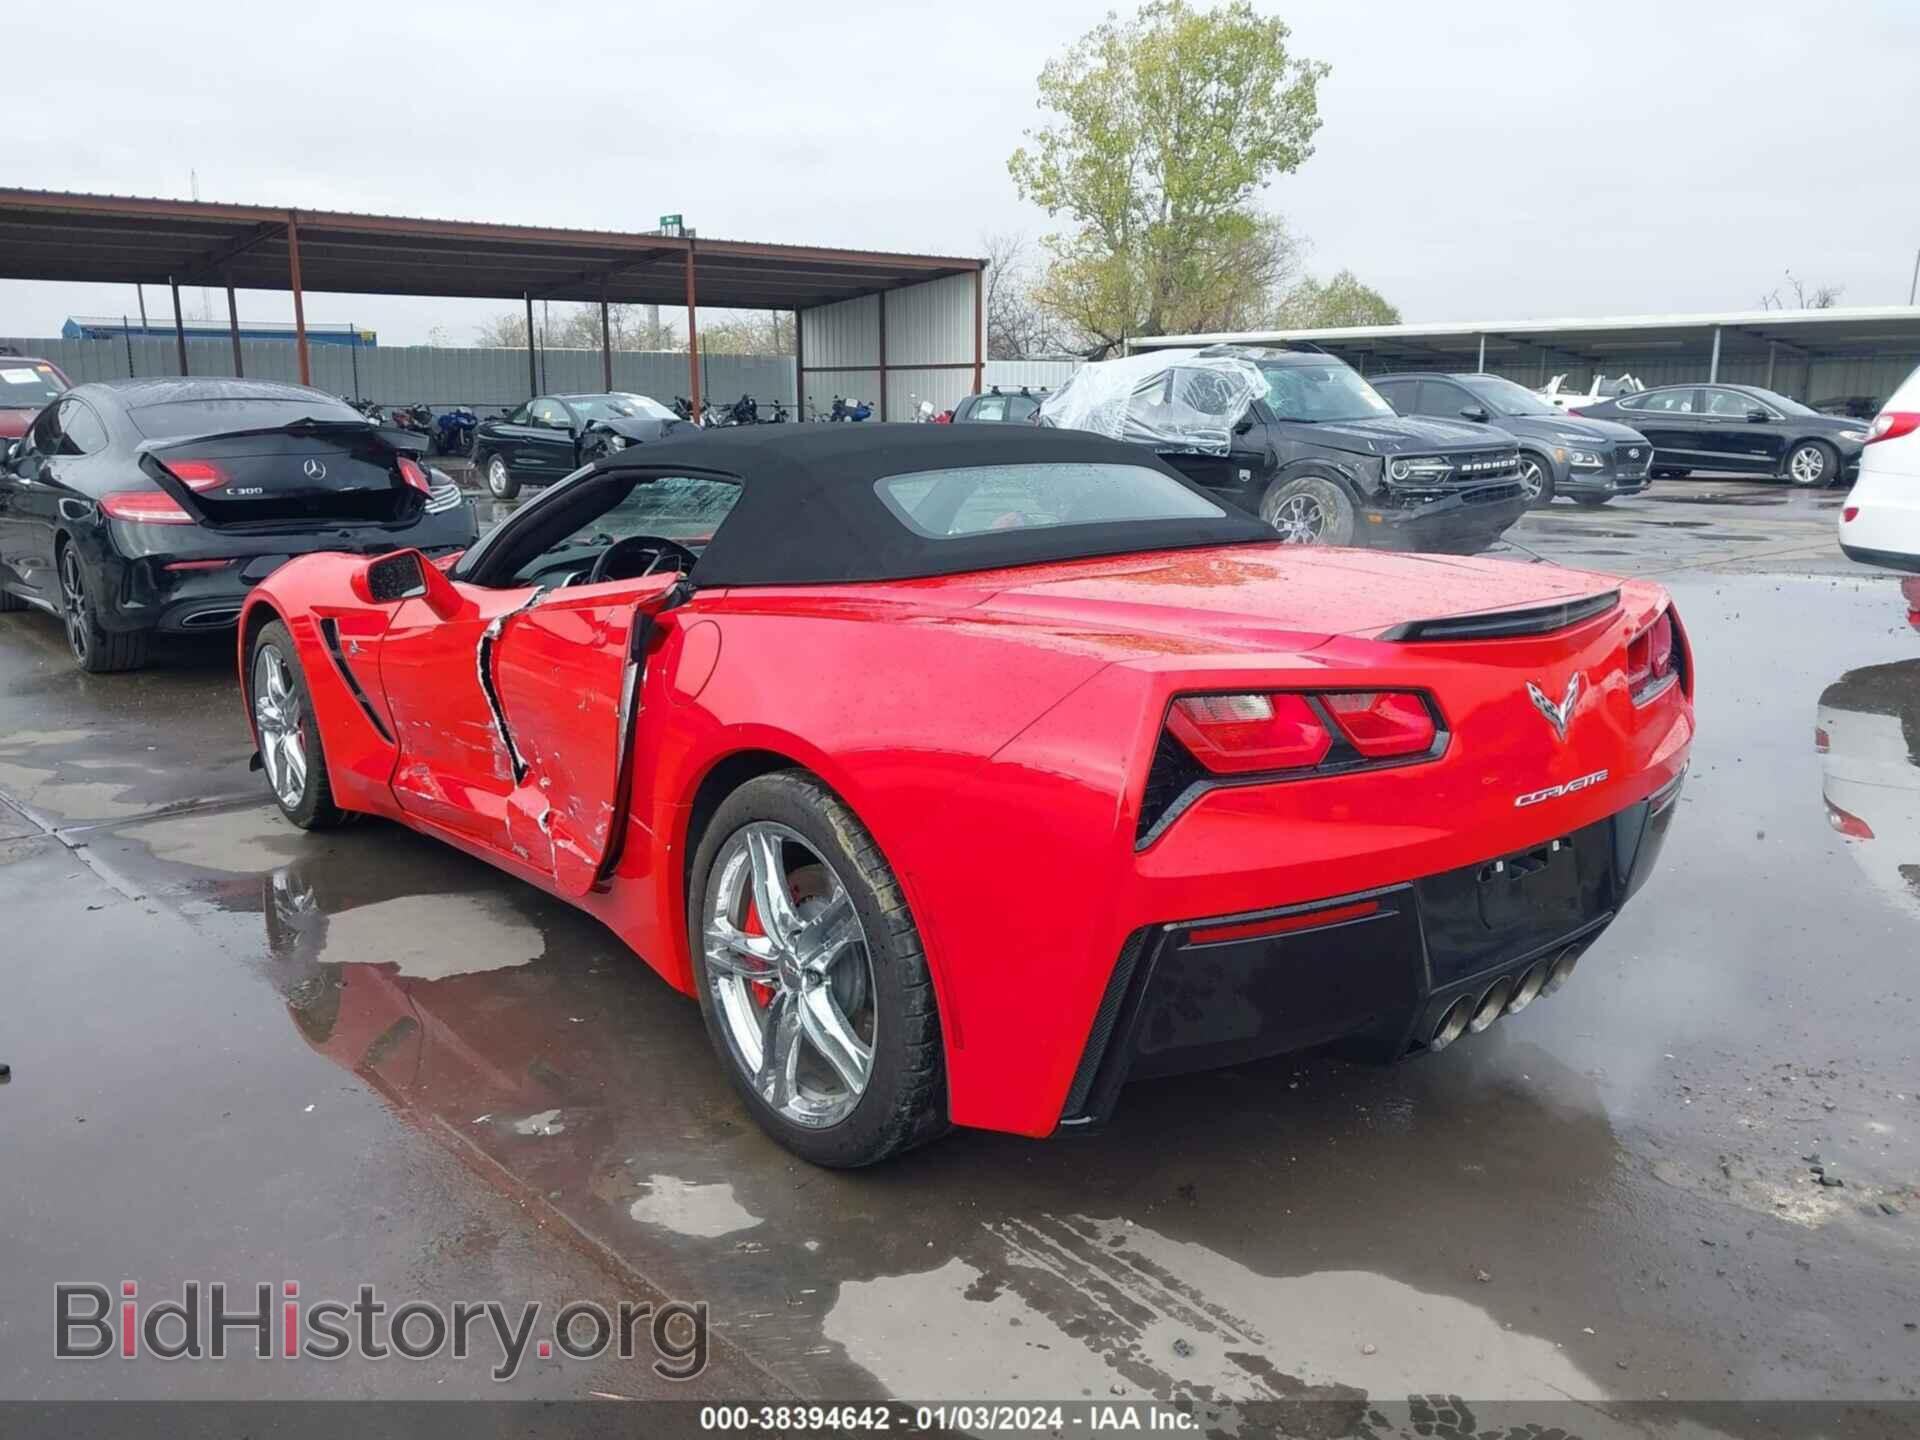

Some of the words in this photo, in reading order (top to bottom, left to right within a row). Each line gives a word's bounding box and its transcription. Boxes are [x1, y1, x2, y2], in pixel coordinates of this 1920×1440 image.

[1461, 460, 1517, 471] BRONCO
[237, 487, 263, 495] 300
[1514, 768, 1609, 807] CORVETTE
